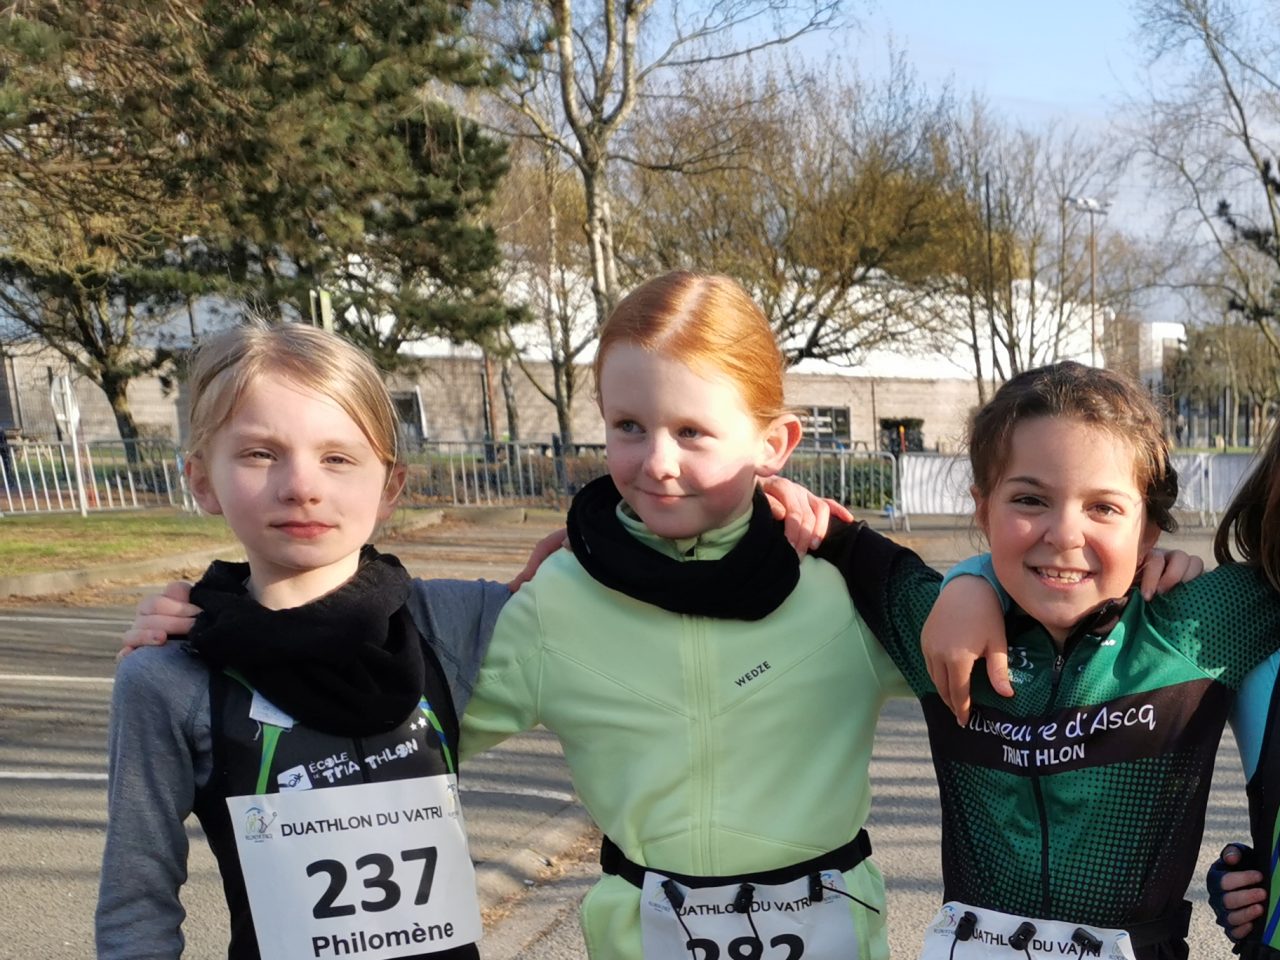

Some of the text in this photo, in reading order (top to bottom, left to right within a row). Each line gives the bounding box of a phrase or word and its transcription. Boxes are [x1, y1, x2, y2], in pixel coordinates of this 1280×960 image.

[734, 660, 771, 687] WEDZE
[281, 814, 373, 837] DUATHLON
[376, 811, 400, 827] DU
[403, 805, 443, 823] VATRI
[306, 846, 438, 920] 237
[750, 900, 771, 913] DU
[774, 897, 813, 912] VATR
[312, 921, 455, 958] Philomène
[1033, 938, 1054, 953] DU
